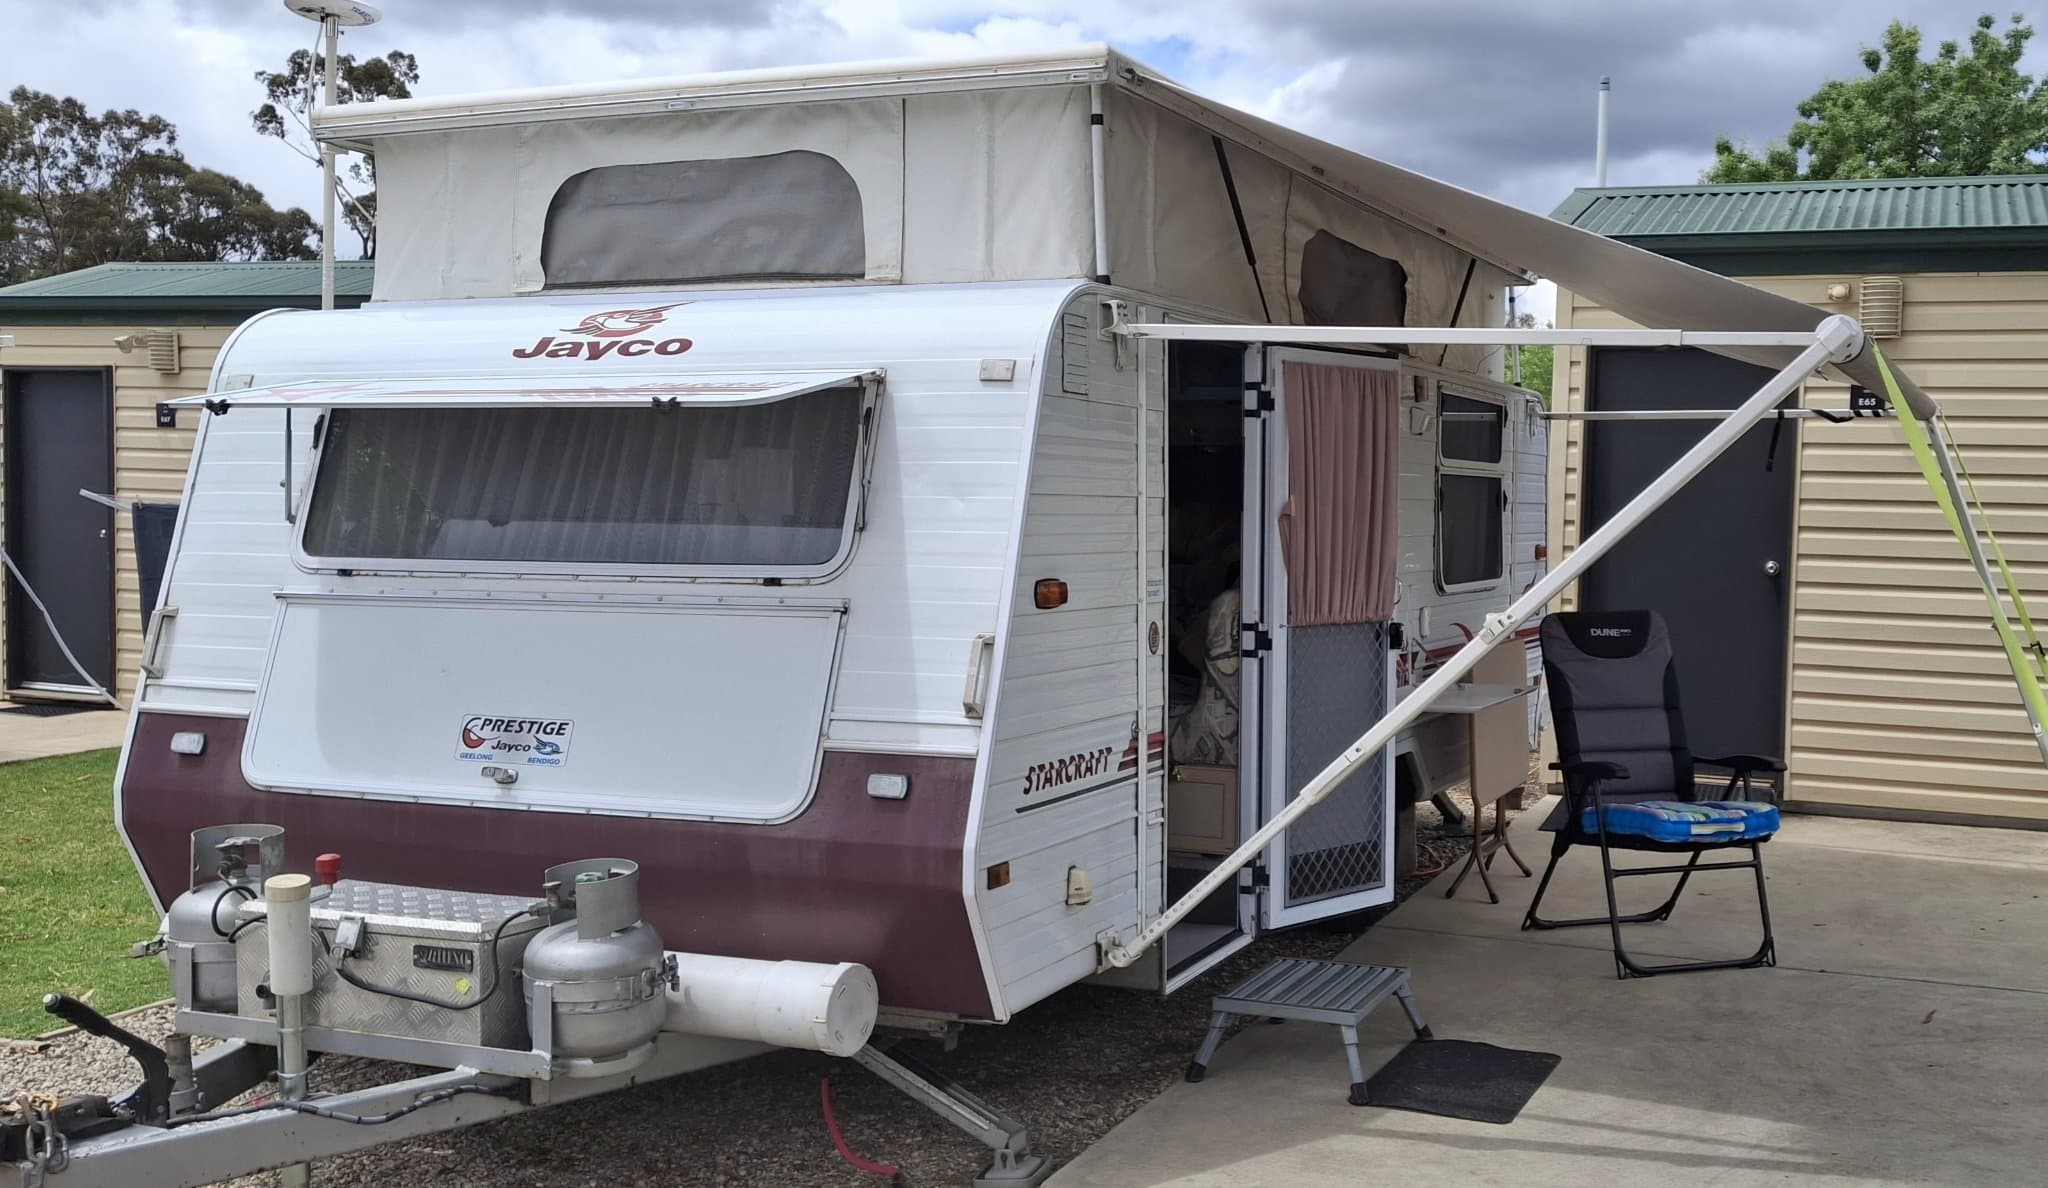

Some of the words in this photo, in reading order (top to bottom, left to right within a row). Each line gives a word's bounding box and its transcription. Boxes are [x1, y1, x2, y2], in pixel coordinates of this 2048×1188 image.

[512, 336, 693, 361] Jayco
[1858, 398, 1877, 406] E65
[1590, 628, 1620, 637] DUNE
[480, 718, 569, 736] PRESTIGE
[491, 740, 531, 753] Jayco
[459, 752, 494, 760] GEELONG
[527, 757, 561, 765] BENDIGO
[1023, 746, 1113, 795] STARCRAFT
